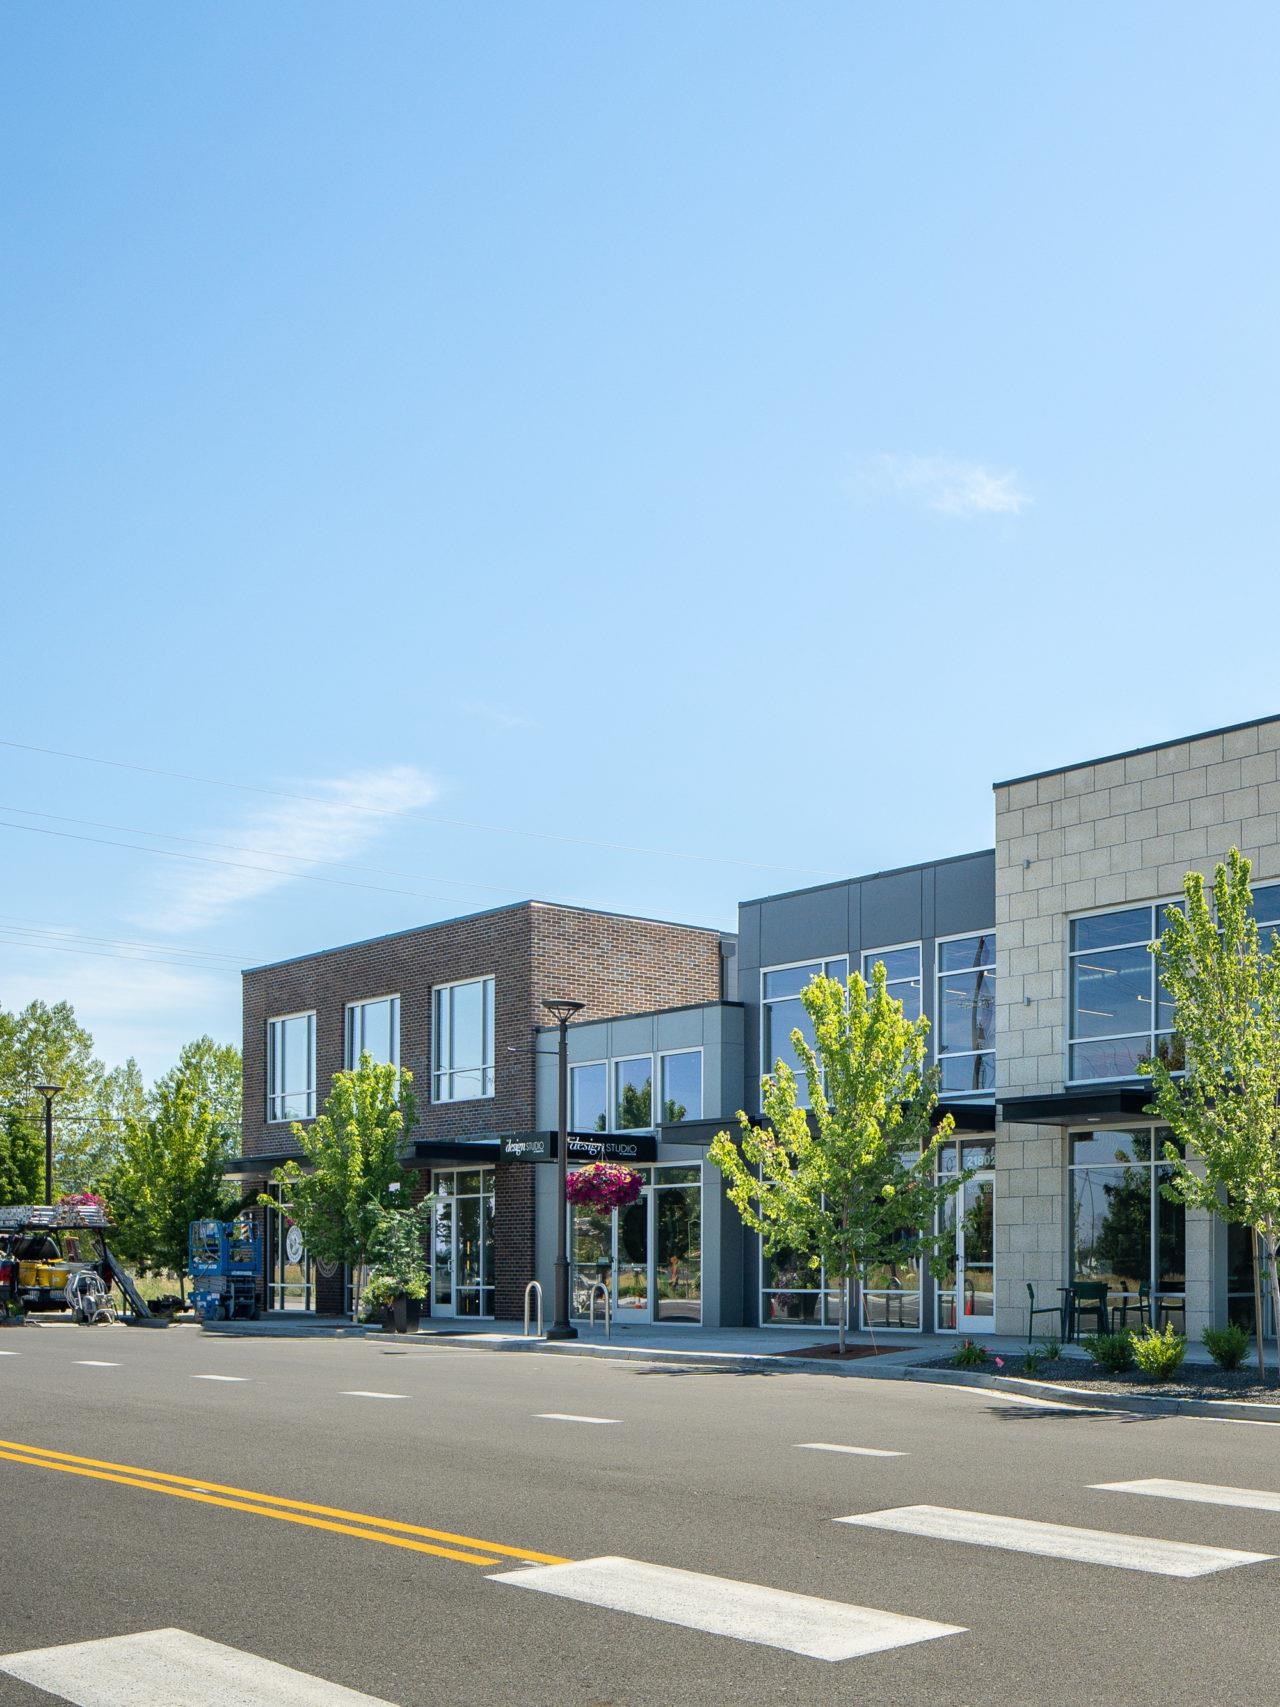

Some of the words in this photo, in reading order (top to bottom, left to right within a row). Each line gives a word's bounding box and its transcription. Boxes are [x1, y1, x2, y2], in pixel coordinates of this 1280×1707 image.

[569, 1136, 605, 1155] design
[606, 1143, 638, 1153] STUDIO
[967, 1155, 996, 1166] 21802
